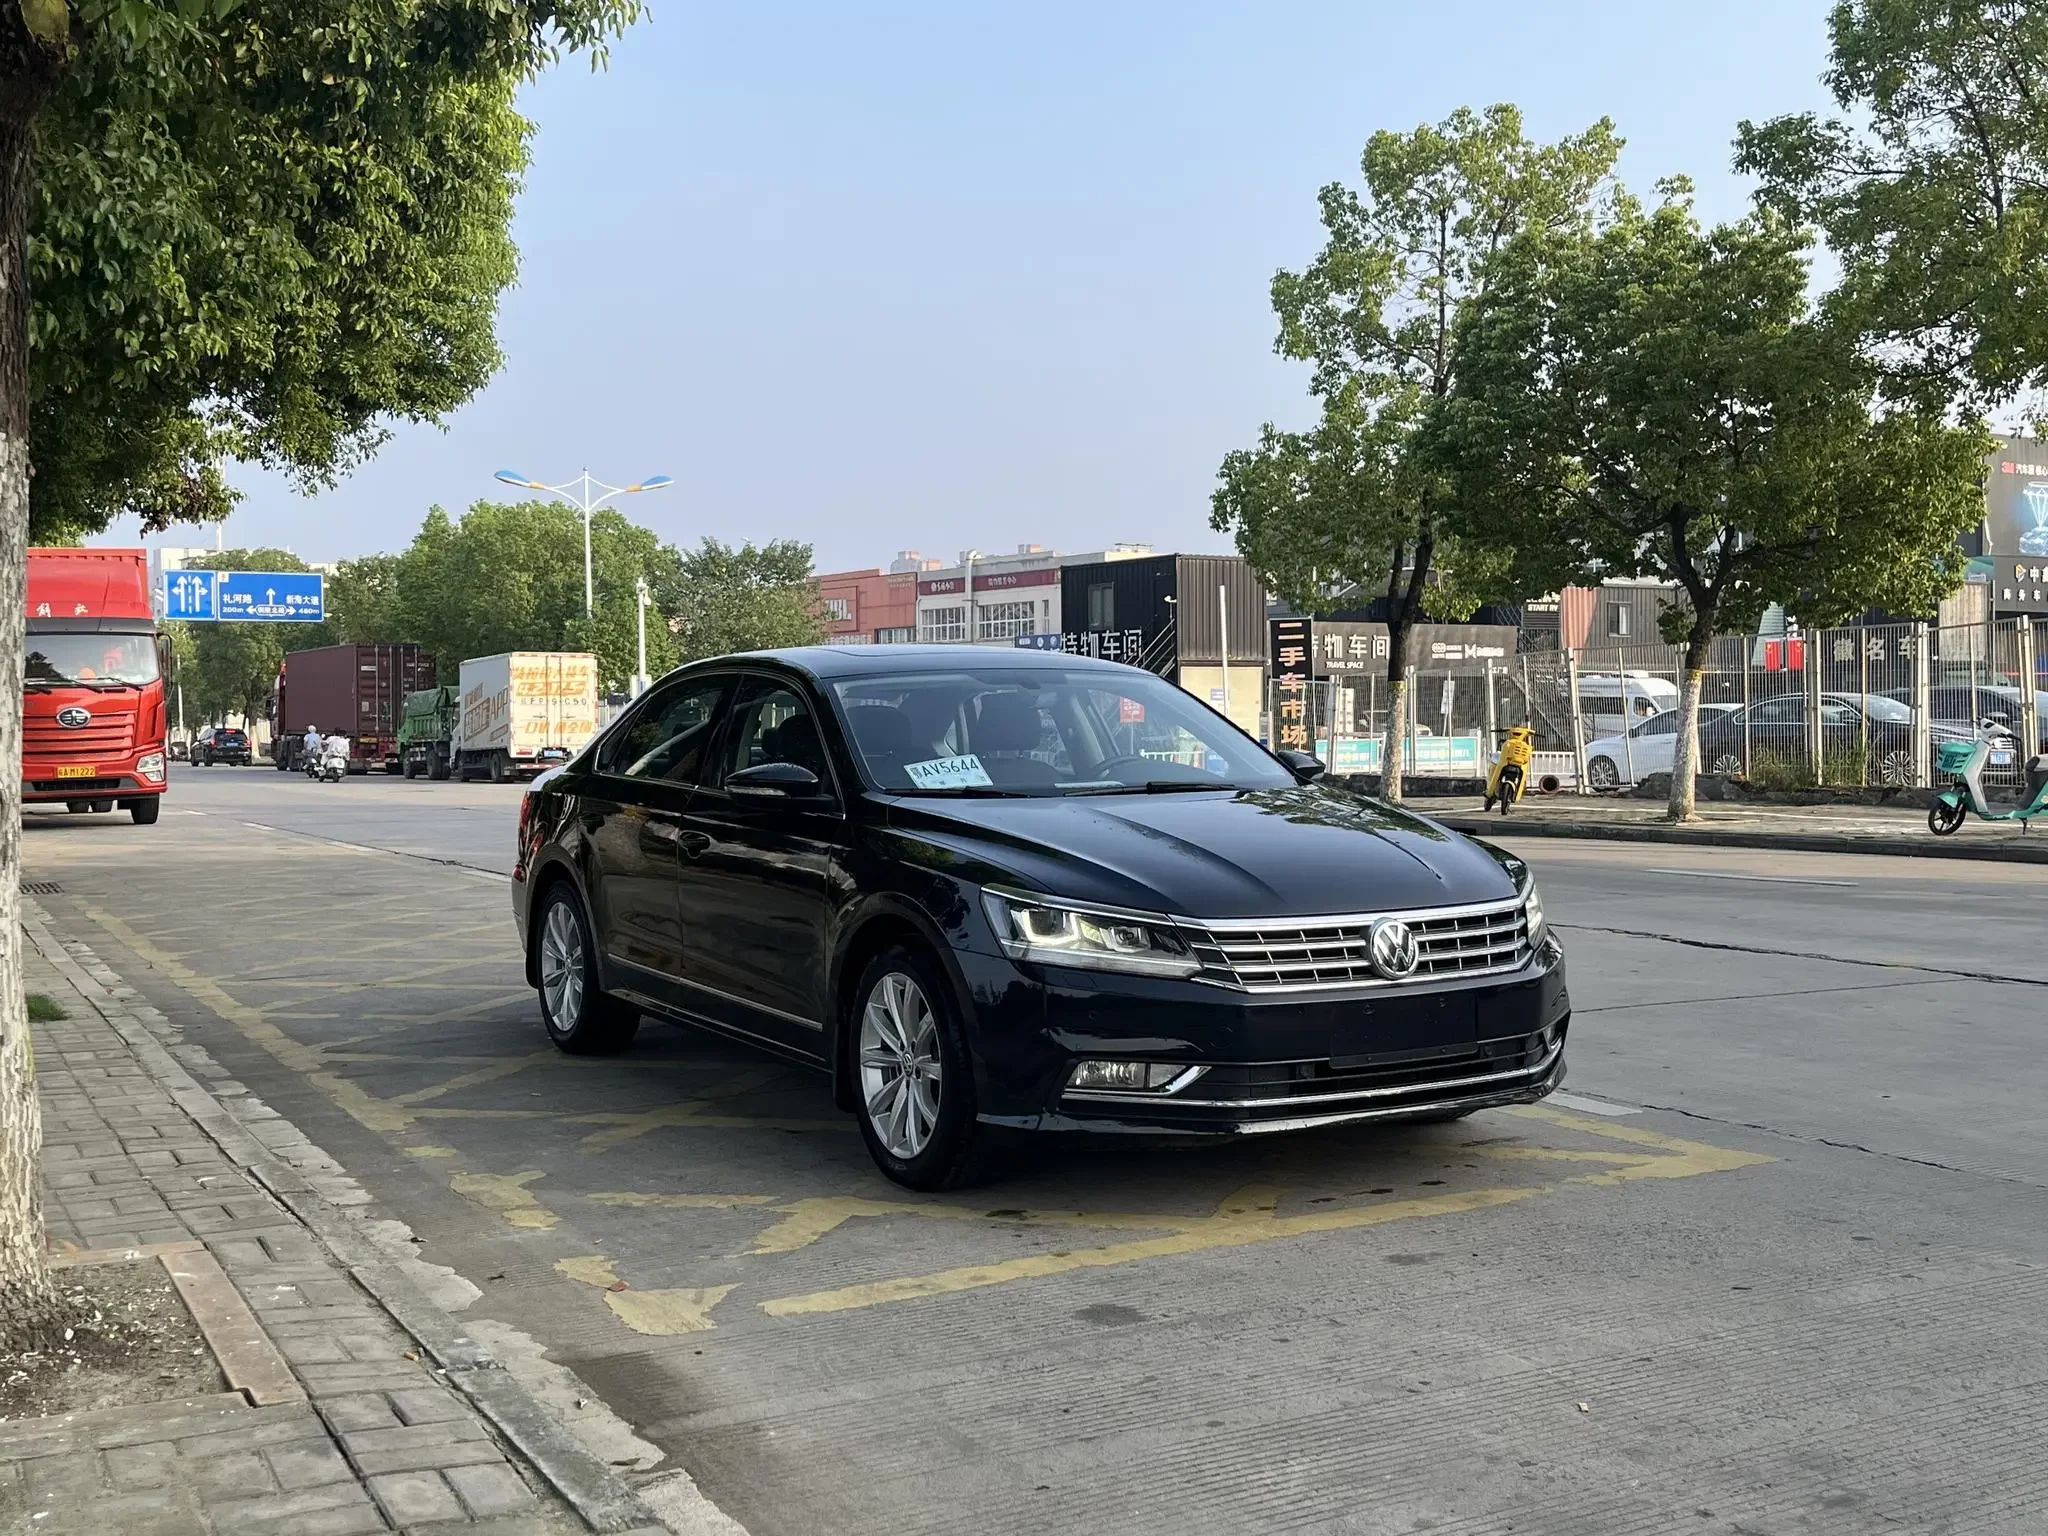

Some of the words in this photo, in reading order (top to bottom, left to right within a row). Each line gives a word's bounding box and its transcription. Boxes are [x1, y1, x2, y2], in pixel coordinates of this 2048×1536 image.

[1278, 622, 1308, 745] 二手车市场
[1326, 661, 1345, 669] TRAVEL
[1346, 661, 1364, 669] SPACE
